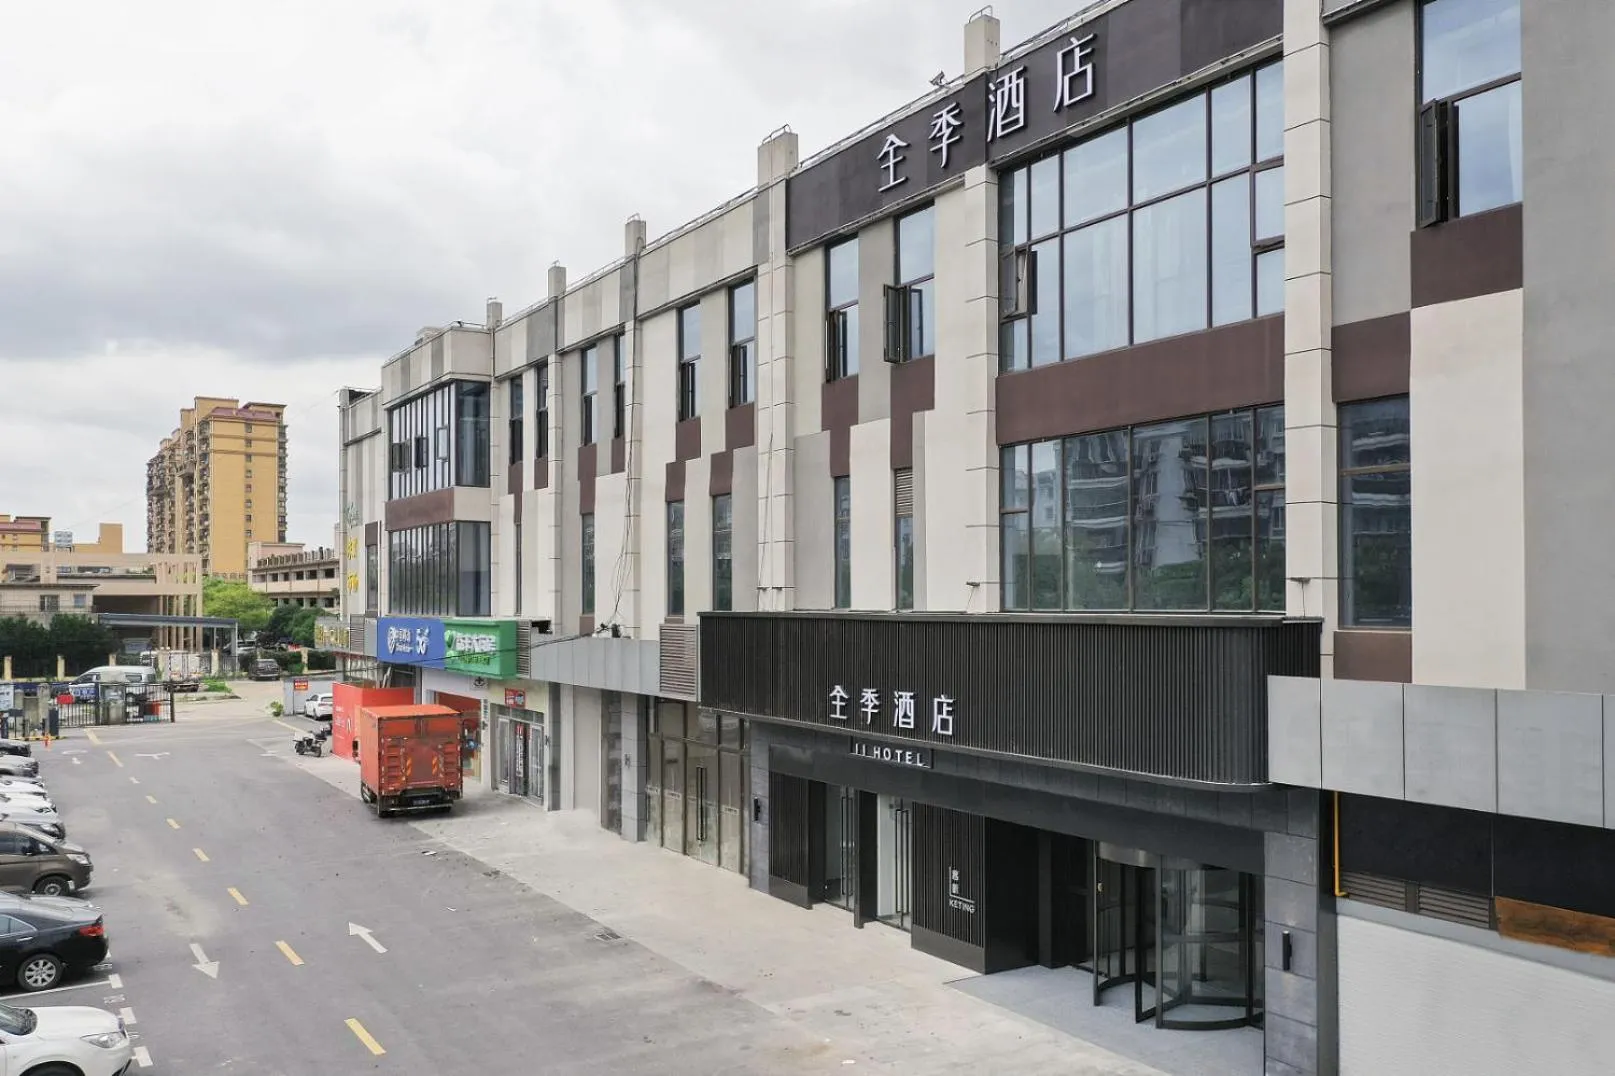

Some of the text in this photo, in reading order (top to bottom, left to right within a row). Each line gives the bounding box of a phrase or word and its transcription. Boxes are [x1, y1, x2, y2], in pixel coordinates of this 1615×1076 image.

[877, 34, 1096, 192] 全季酒店
[829, 685, 955, 735] 全季酒店
[873, 746, 923, 766] HOTEL
